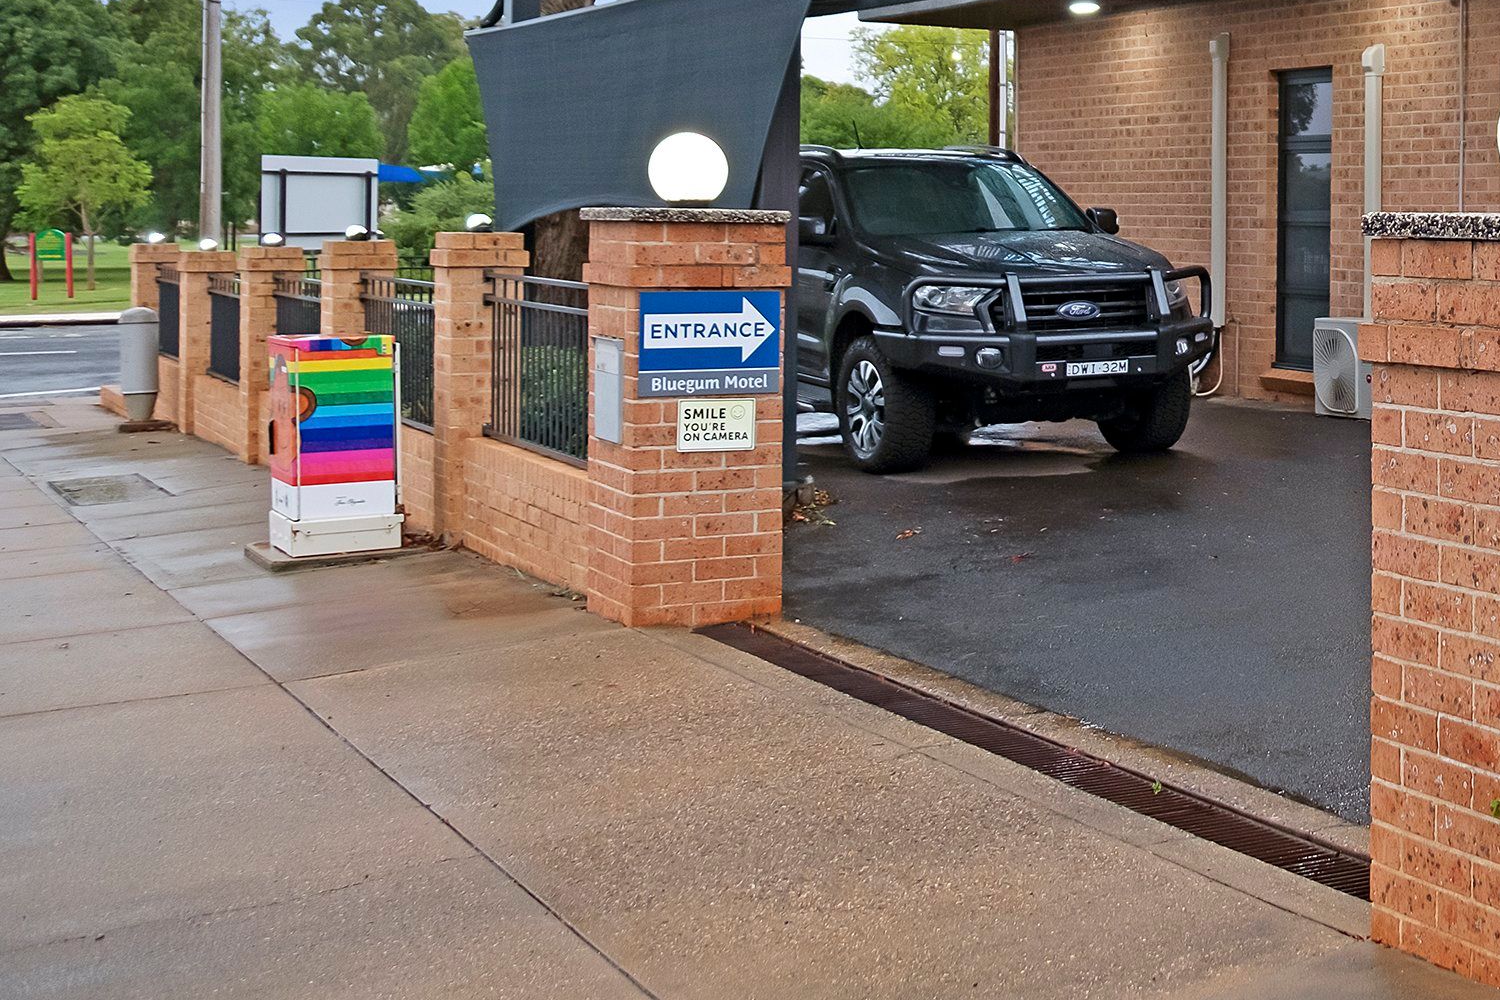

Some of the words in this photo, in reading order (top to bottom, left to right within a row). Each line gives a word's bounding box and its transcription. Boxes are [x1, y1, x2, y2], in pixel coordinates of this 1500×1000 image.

[1069, 305, 1092, 315] Ford
[650, 322, 765, 339] ENTRANCE
[651, 377, 720, 393] Bluegum
[725, 374, 768, 389] Motel
[684, 408, 726, 419] SMILE
[684, 423, 726, 431] YOU'RE
[683, 433, 700, 442] ON
[703, 432, 748, 440] CAMERA
